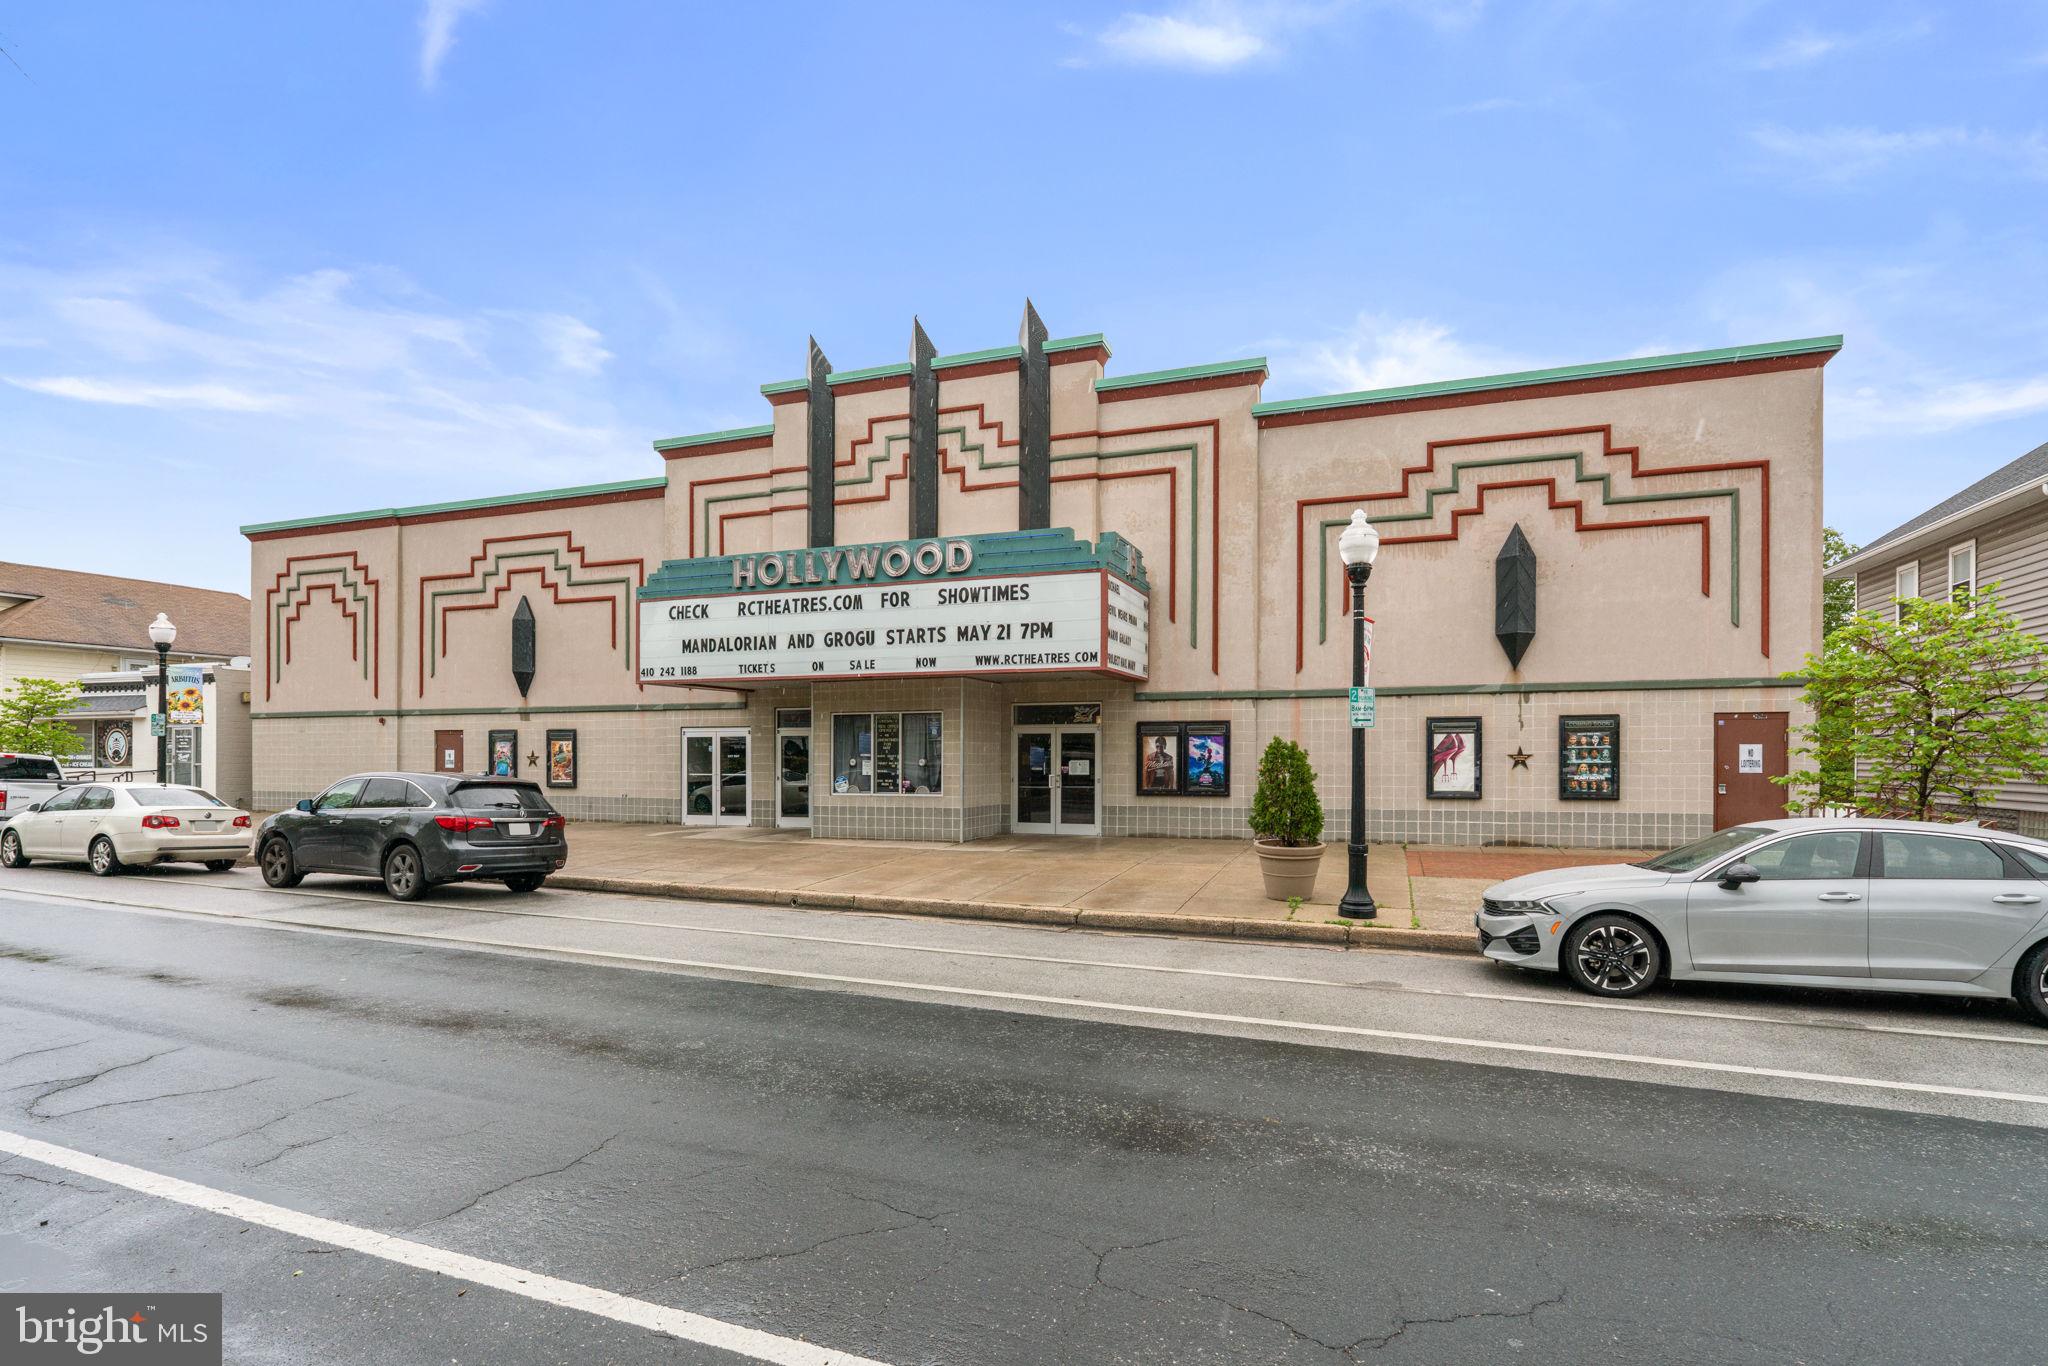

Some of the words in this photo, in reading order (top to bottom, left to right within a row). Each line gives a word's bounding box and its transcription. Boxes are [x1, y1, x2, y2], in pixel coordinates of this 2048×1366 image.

[733, 539, 973, 589] HOLLYWOOD
[669, 604, 710, 620] CHECK
[737, 594, 863, 617] RCTHEATRES.COM
[881, 591, 910, 608] FOR
[938, 583, 1030, 605] SHOWTIMES
[682, 634, 777, 654] MANDALORIAN
[788, 633, 815, 649] AND
[824, 630, 876, 648] GROGU
[886, 626, 947, 645] STARTS
[957, 624, 992, 642] MAY
[996, 624, 1011, 641] 21
[1020, 622, 1053, 640] 7PM
[640, 668, 654, 677] 410
[660, 667, 675, 677] 242
[681, 666, 698, 676] 1188
[739, 663, 776, 674] TICKETS
[812, 661, 824, 672] ON
[850, 660, 875, 670] SALE
[916, 657, 937, 668] NOW
[171, 675, 200, 685] ARBUTUS
[1352, 690, 1357, 701] 2
